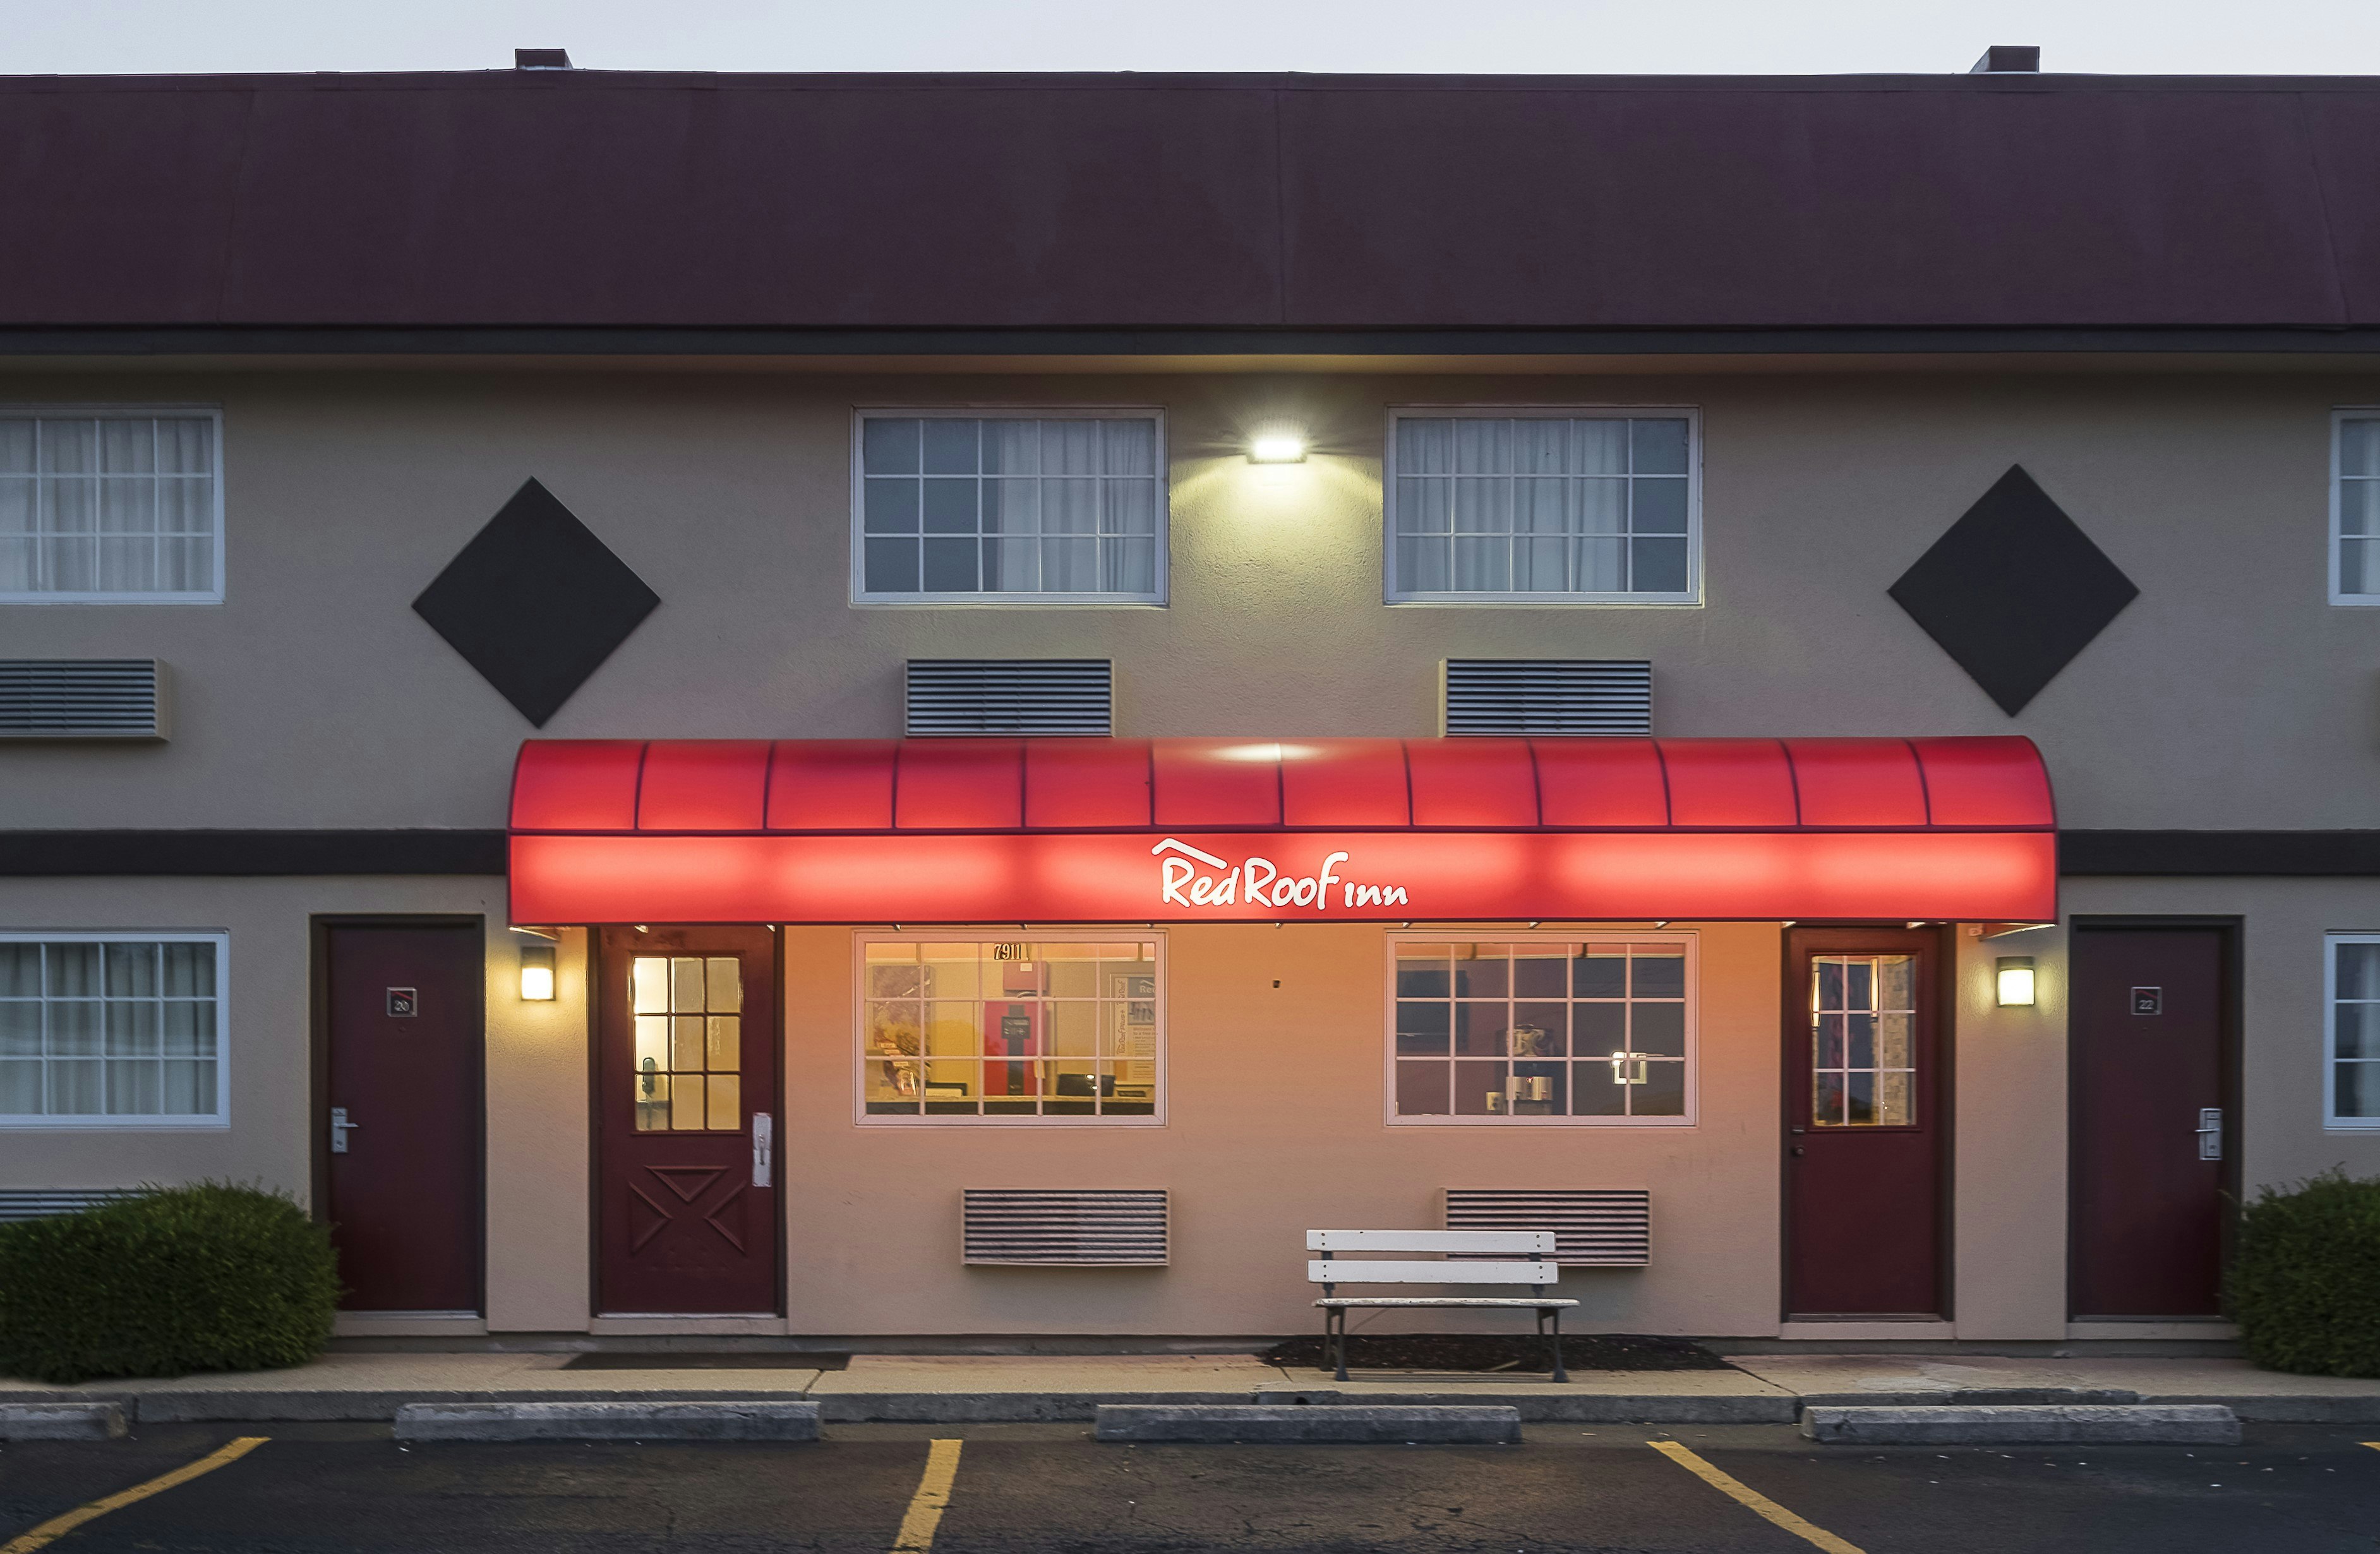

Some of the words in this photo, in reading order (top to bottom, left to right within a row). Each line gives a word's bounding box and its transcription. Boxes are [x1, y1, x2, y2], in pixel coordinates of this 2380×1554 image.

[994, 943, 1021, 960] 7911
[394, 1000, 409, 1011] 20
[2139, 1000, 2155, 1010] 22
